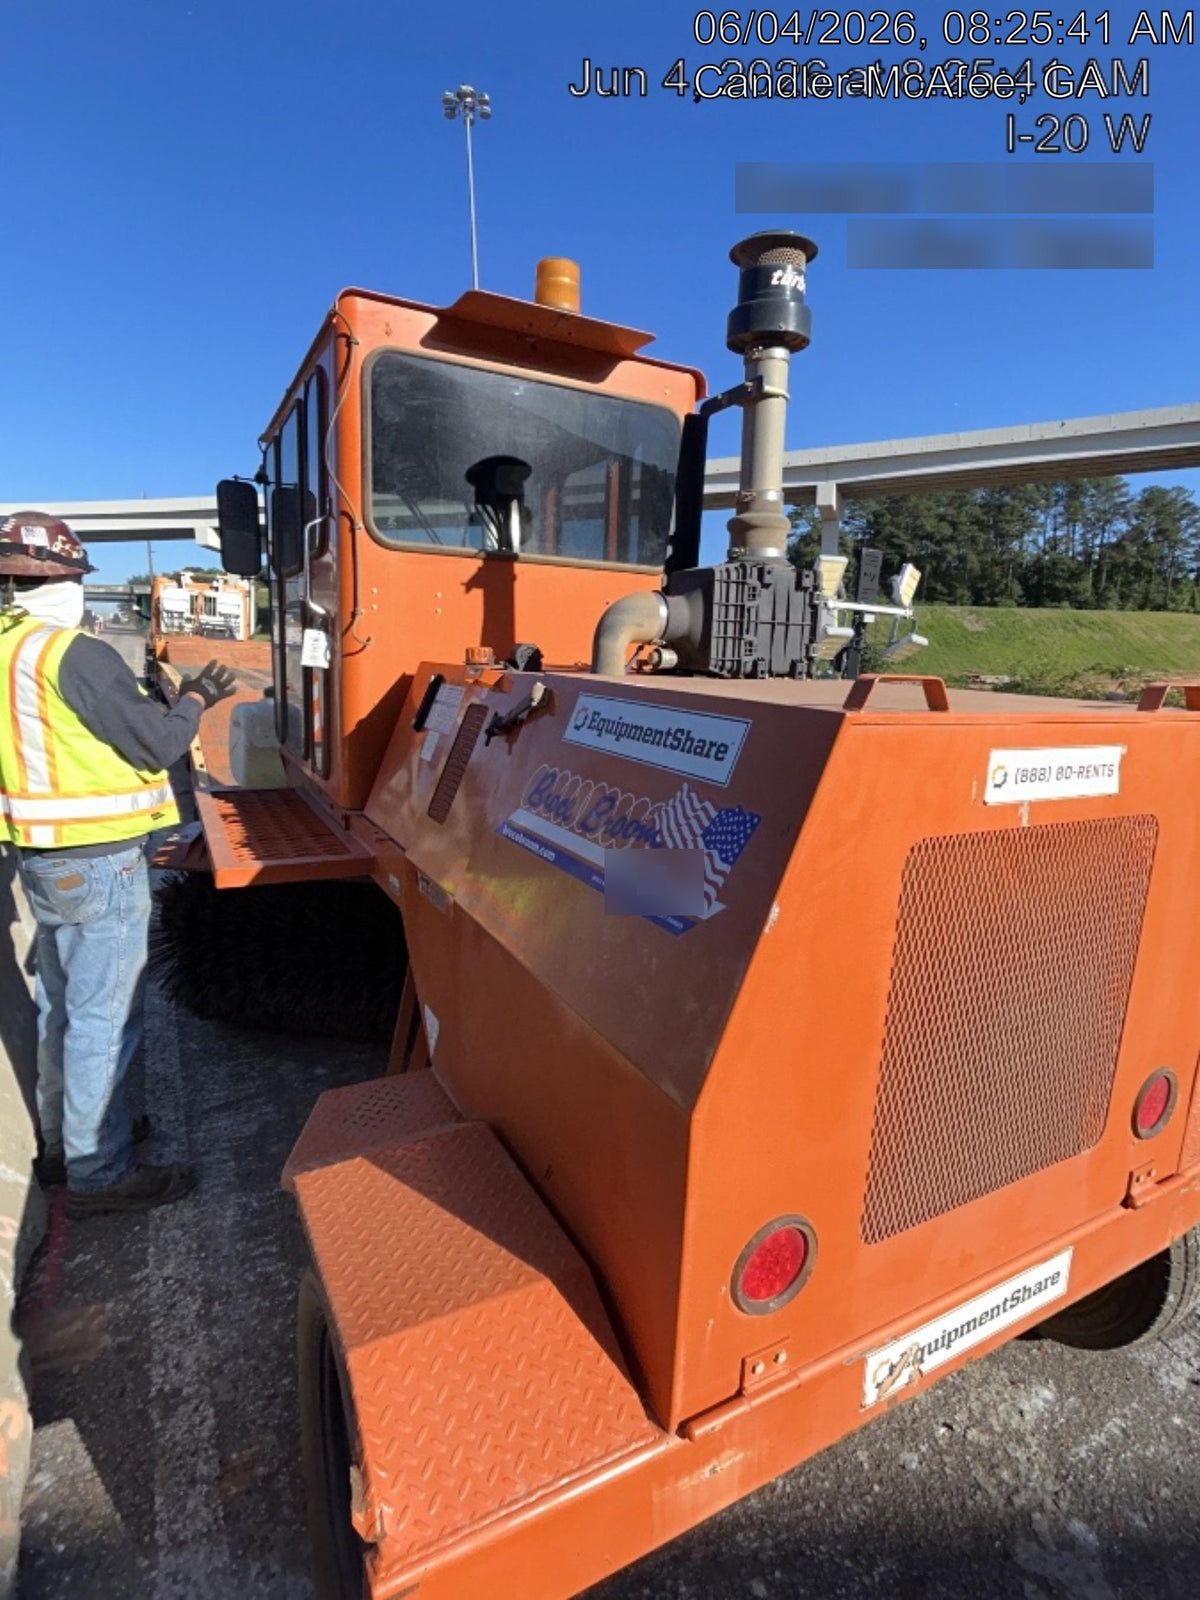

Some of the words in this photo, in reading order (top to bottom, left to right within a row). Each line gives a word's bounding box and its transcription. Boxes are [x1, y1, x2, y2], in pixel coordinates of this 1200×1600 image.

[587, 710, 730, 762] EquipmentShare
[1014, 766, 1052, 785] (888)
[898, 1269, 1061, 1368] quipmentShare
